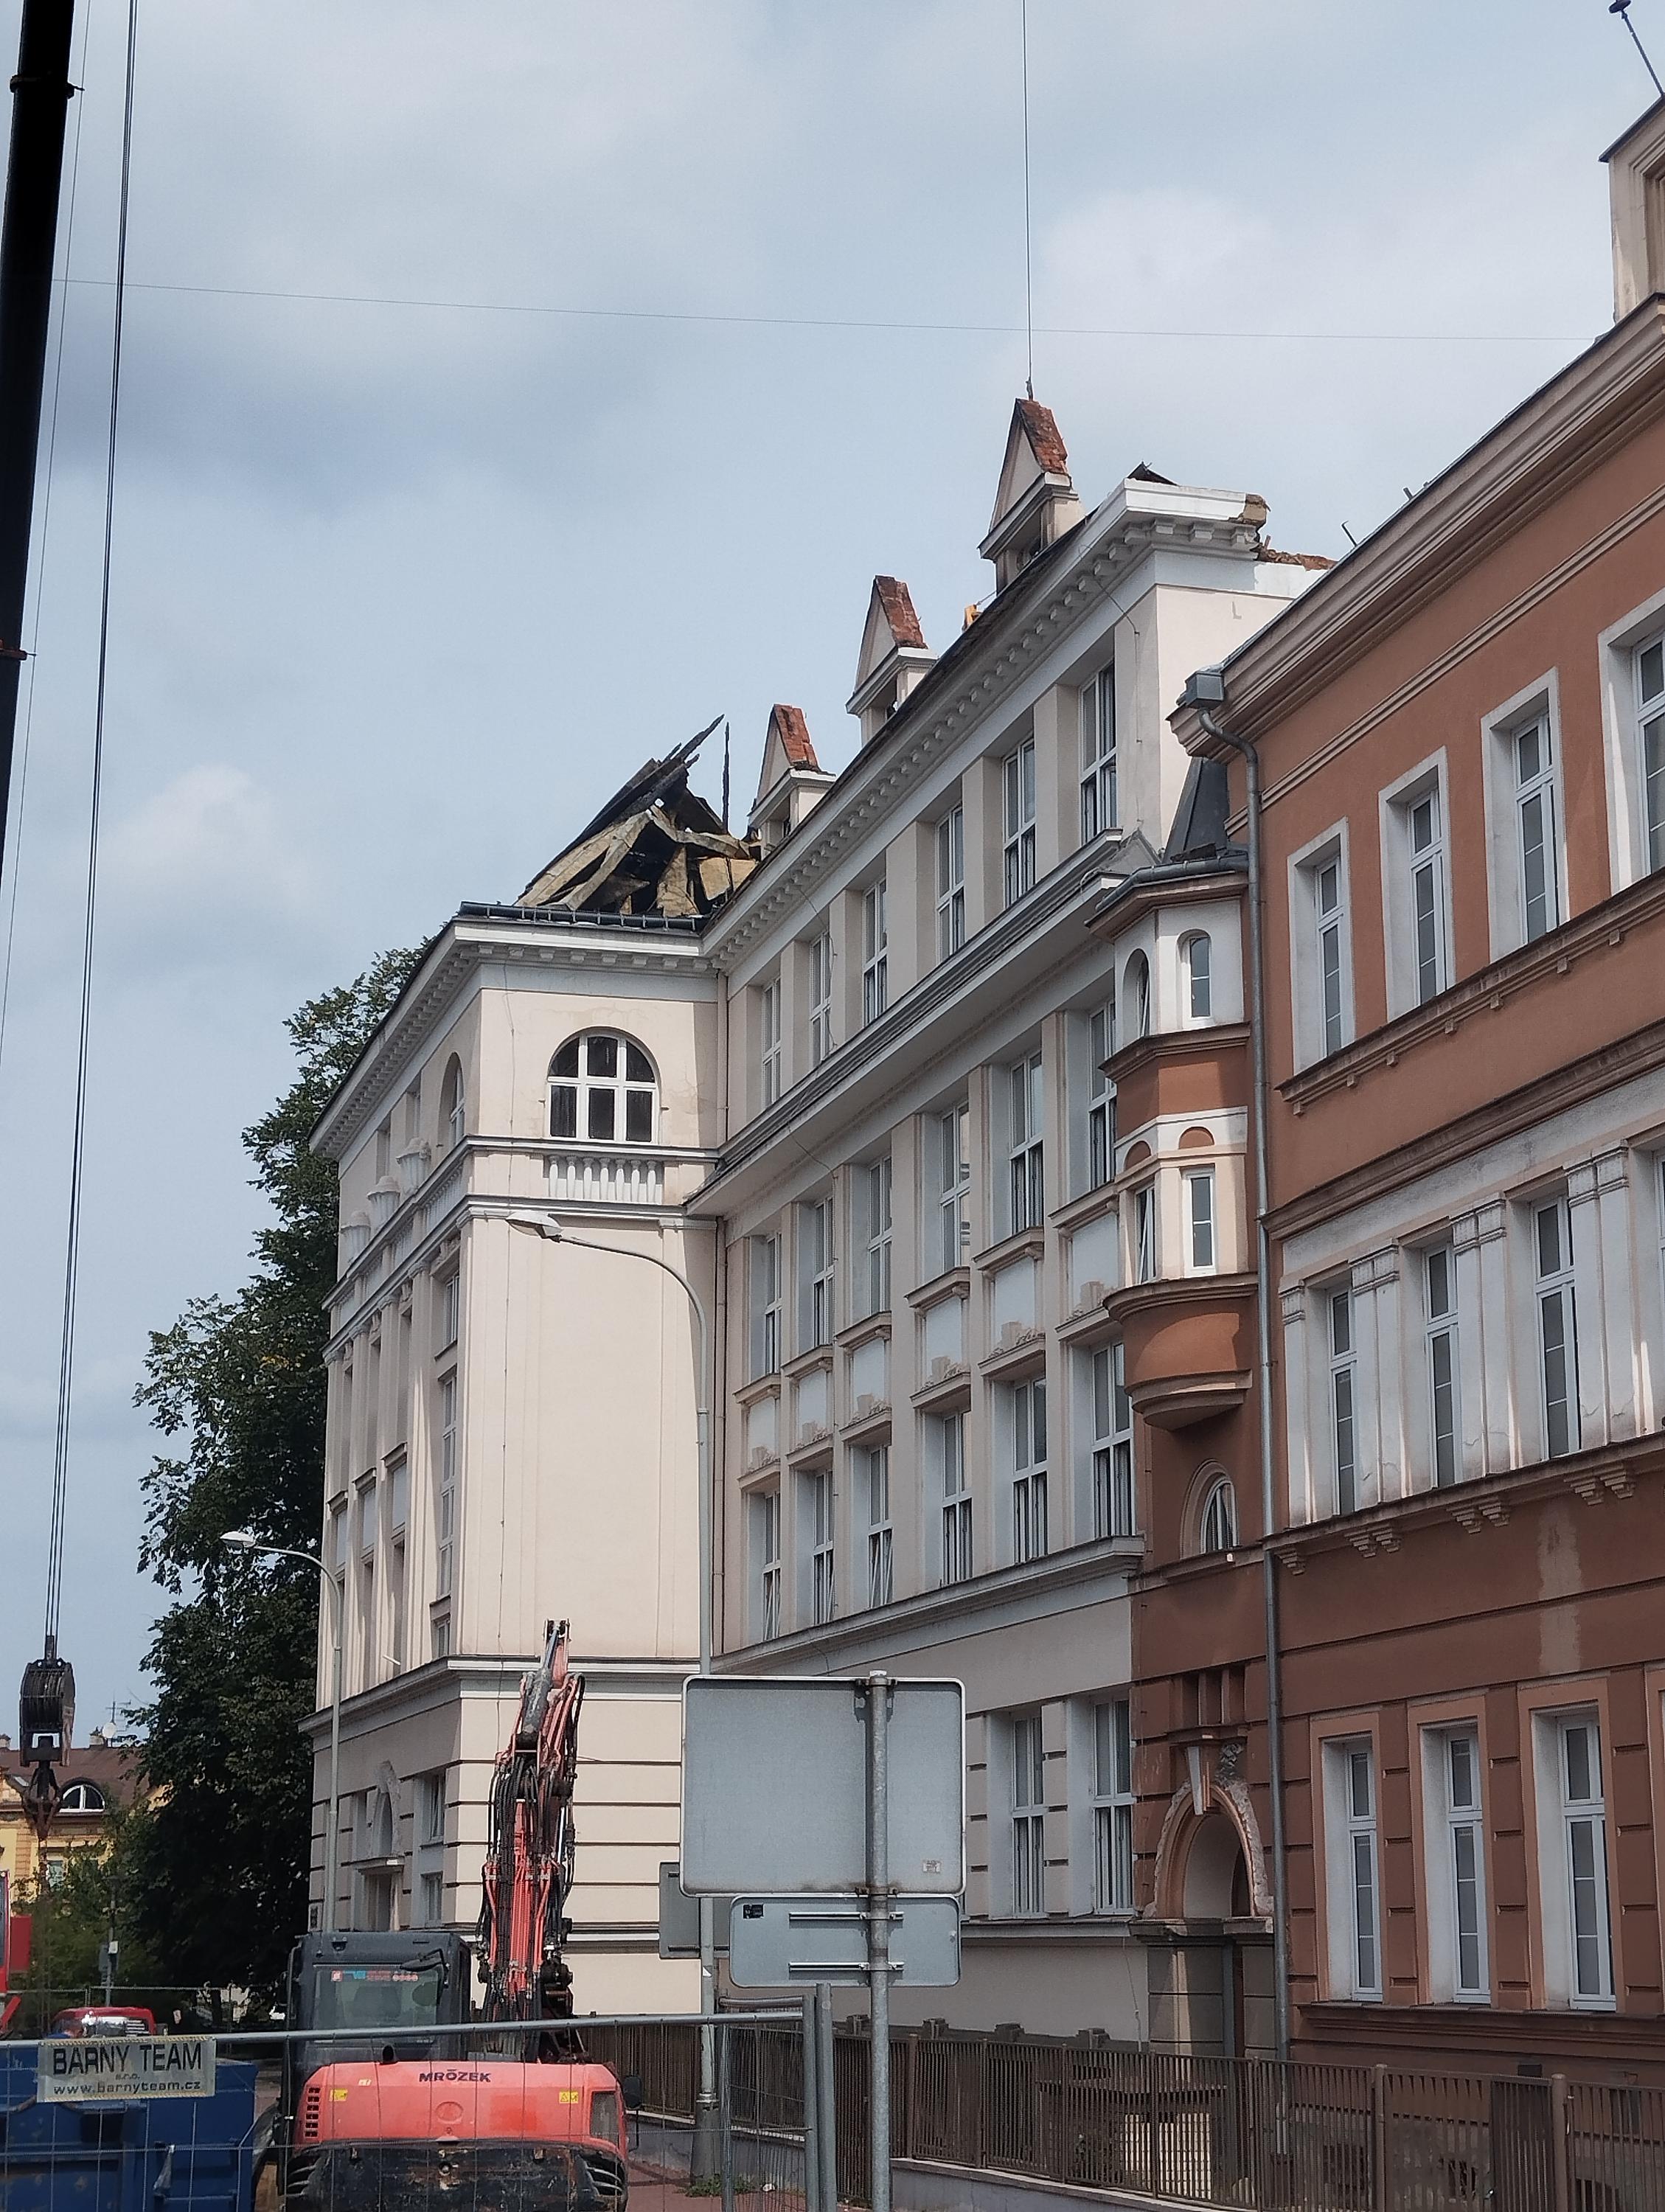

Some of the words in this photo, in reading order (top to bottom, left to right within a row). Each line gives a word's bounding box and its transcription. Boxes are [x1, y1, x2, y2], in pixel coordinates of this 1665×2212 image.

[53, 2045, 130, 2075] BARNY
[139, 2042, 201, 2072] TEAM
[54, 2081, 201, 2094] www.barnyteam.cz
